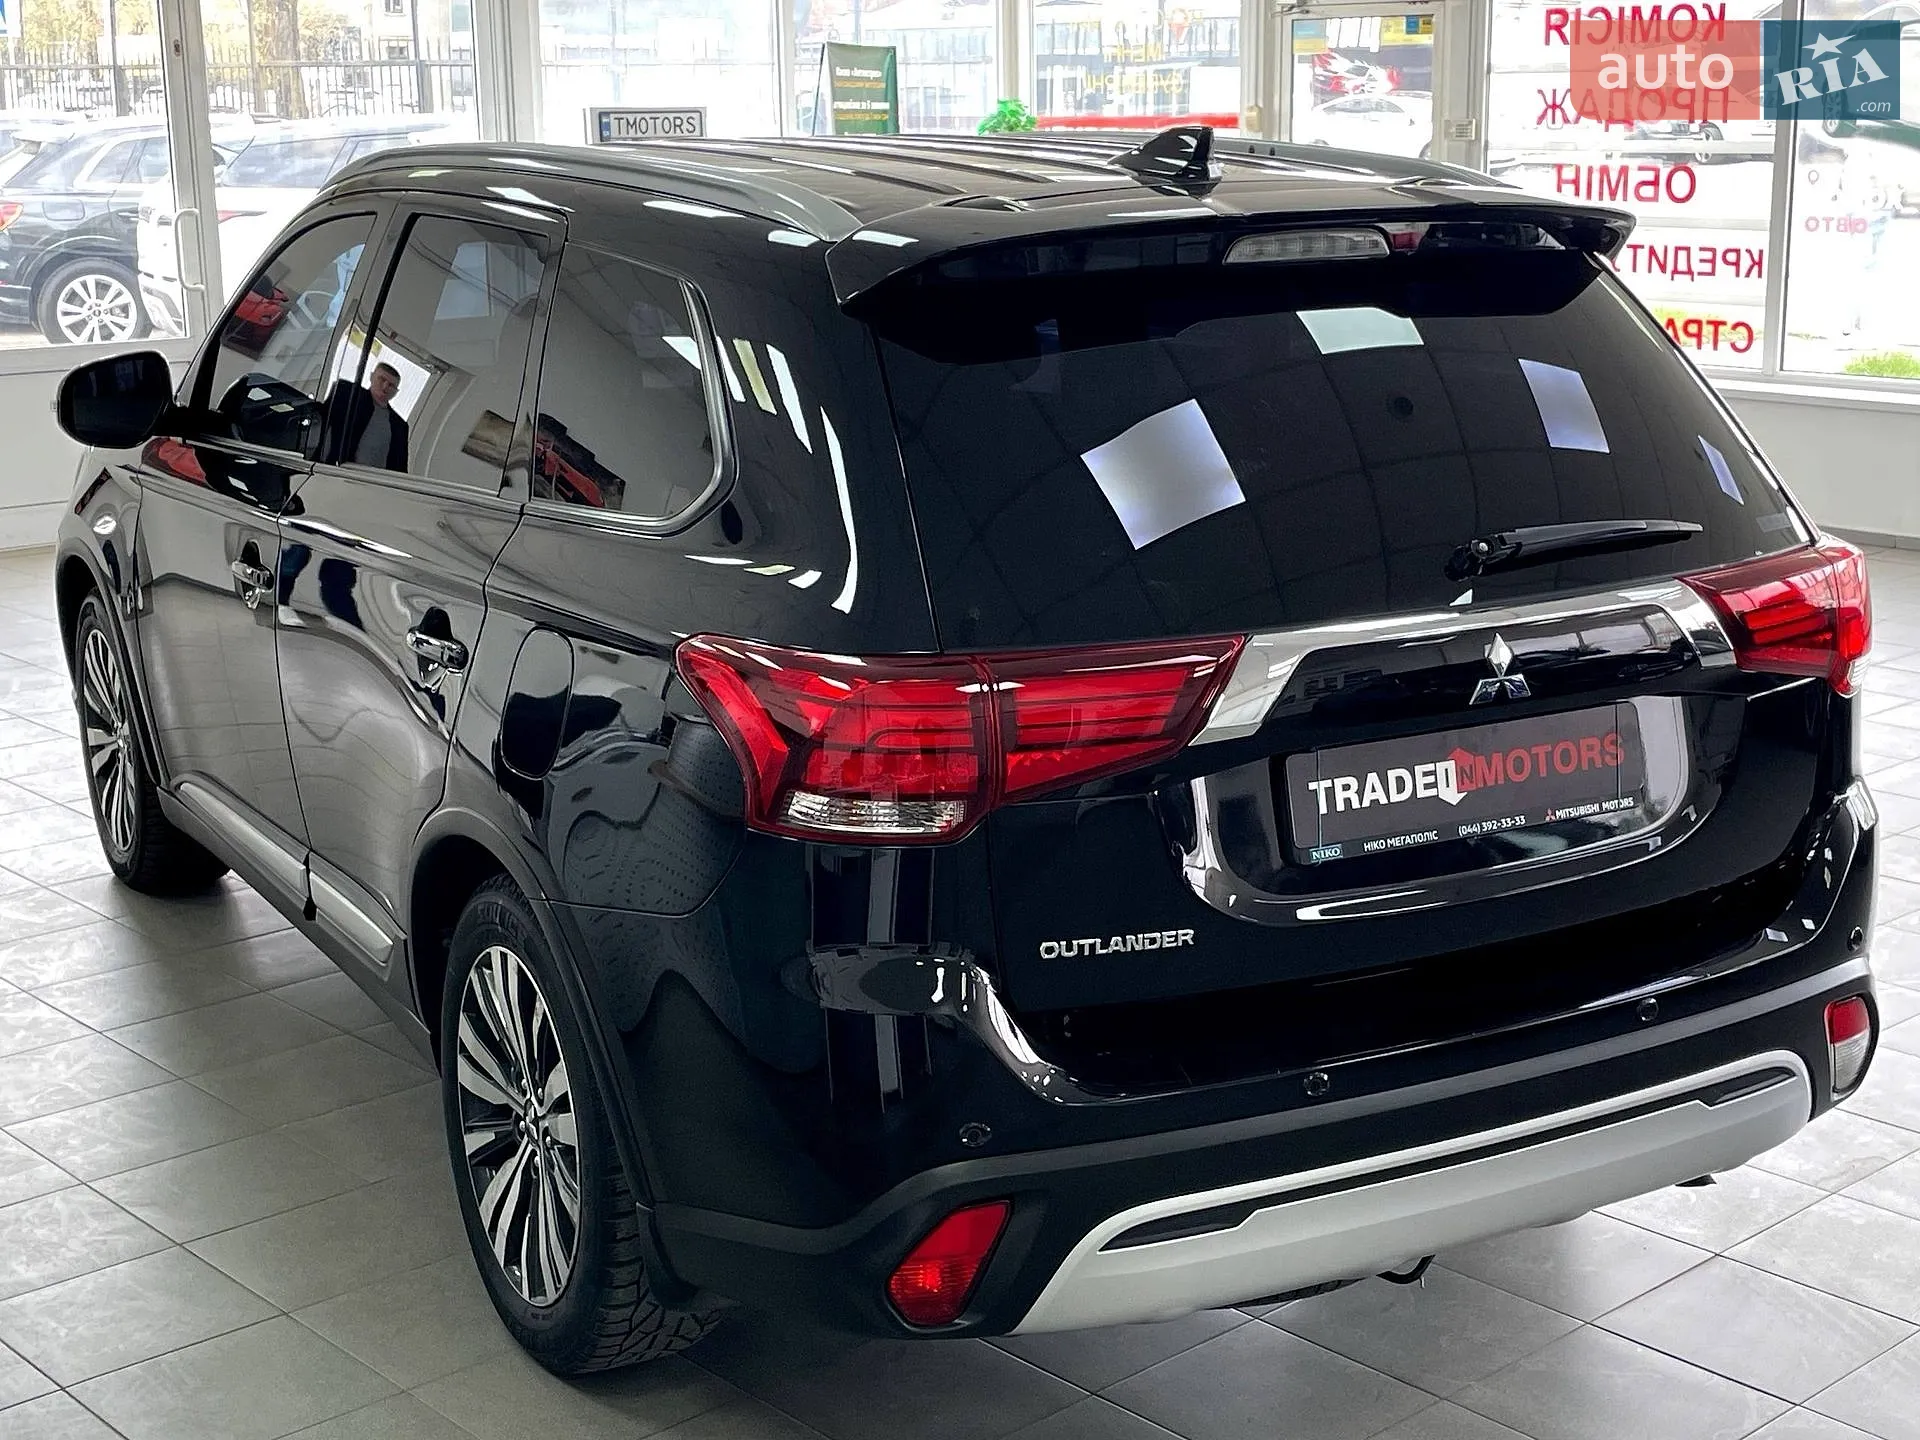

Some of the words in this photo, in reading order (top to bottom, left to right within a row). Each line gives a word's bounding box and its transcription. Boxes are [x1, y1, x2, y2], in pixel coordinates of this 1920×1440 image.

[613, 116, 696, 136] TMOTORS
[1308, 761, 1437, 815] TRADE
[1474, 733, 1626, 789] MOTORS
[1555, 802, 1600, 820] MITSUBISHI
[1602, 797, 1634, 812] MOTORS
[1458, 822, 1481, 837] (044)
[1482, 815, 1526, 832] 392-33-33
[1311, 847, 1341, 860] NIKO
[1039, 928, 1195, 959] OUTLANDER
